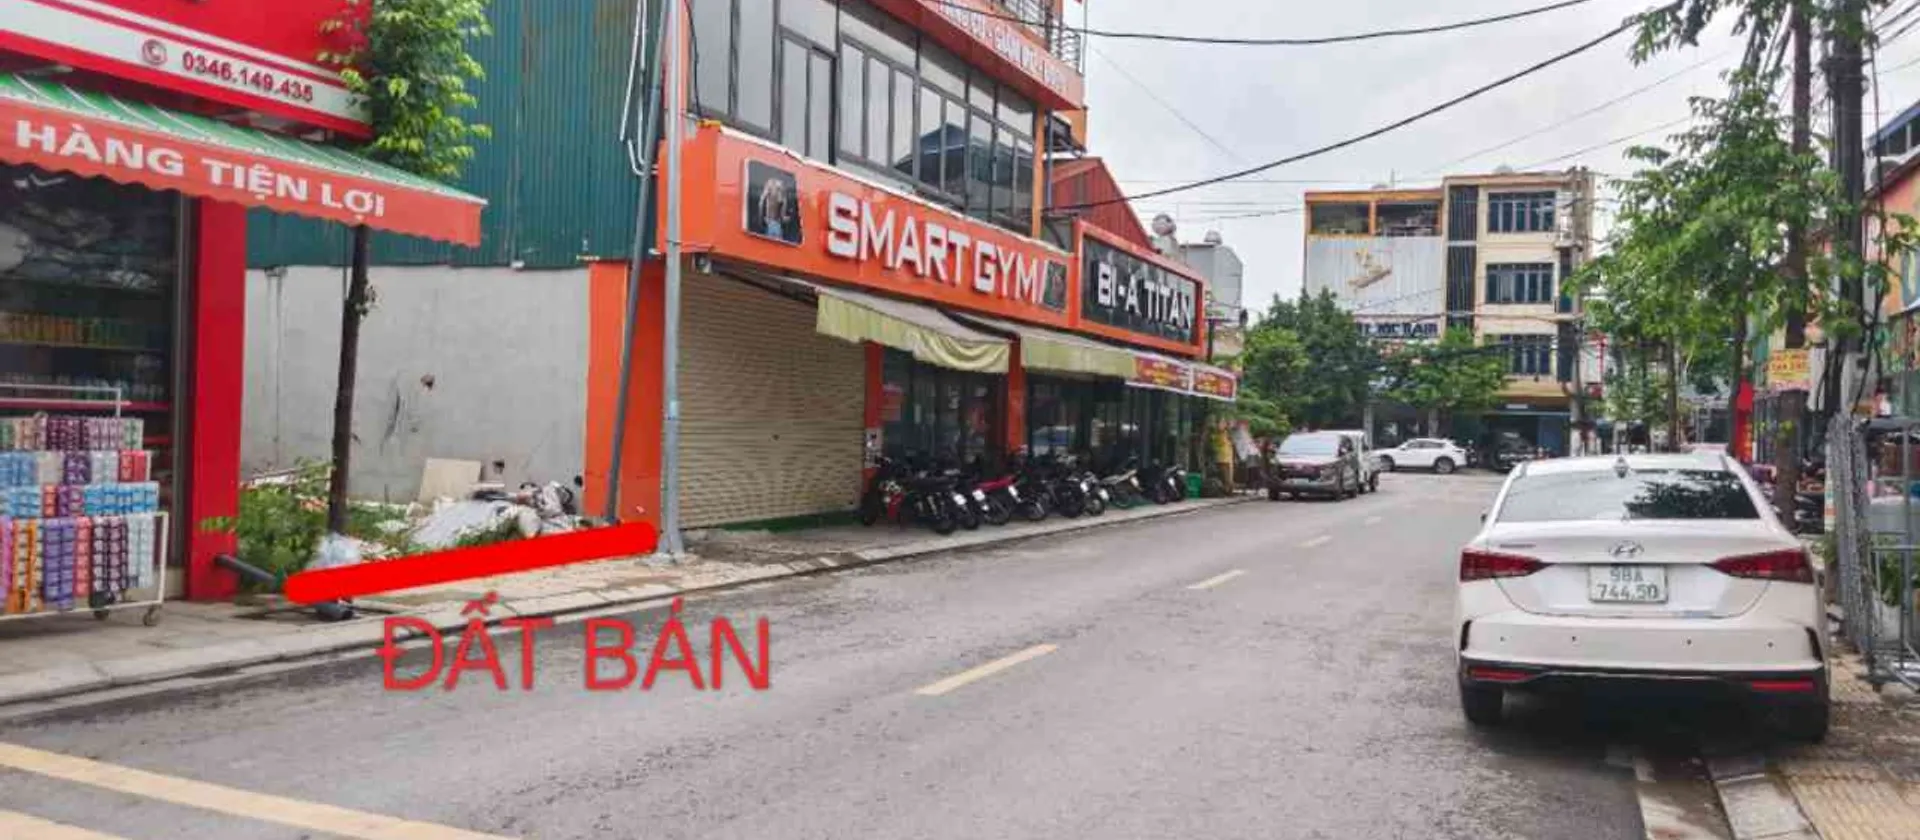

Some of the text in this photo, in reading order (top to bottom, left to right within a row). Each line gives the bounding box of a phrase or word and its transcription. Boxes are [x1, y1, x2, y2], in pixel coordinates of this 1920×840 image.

[182, 50, 313, 102] 0346.149.435
[16, 120, 385, 222] HÀNG TIỆN LỢI
[827, 190, 1038, 305] SMART GYM
[1144, 280, 1192, 330] TITAN
